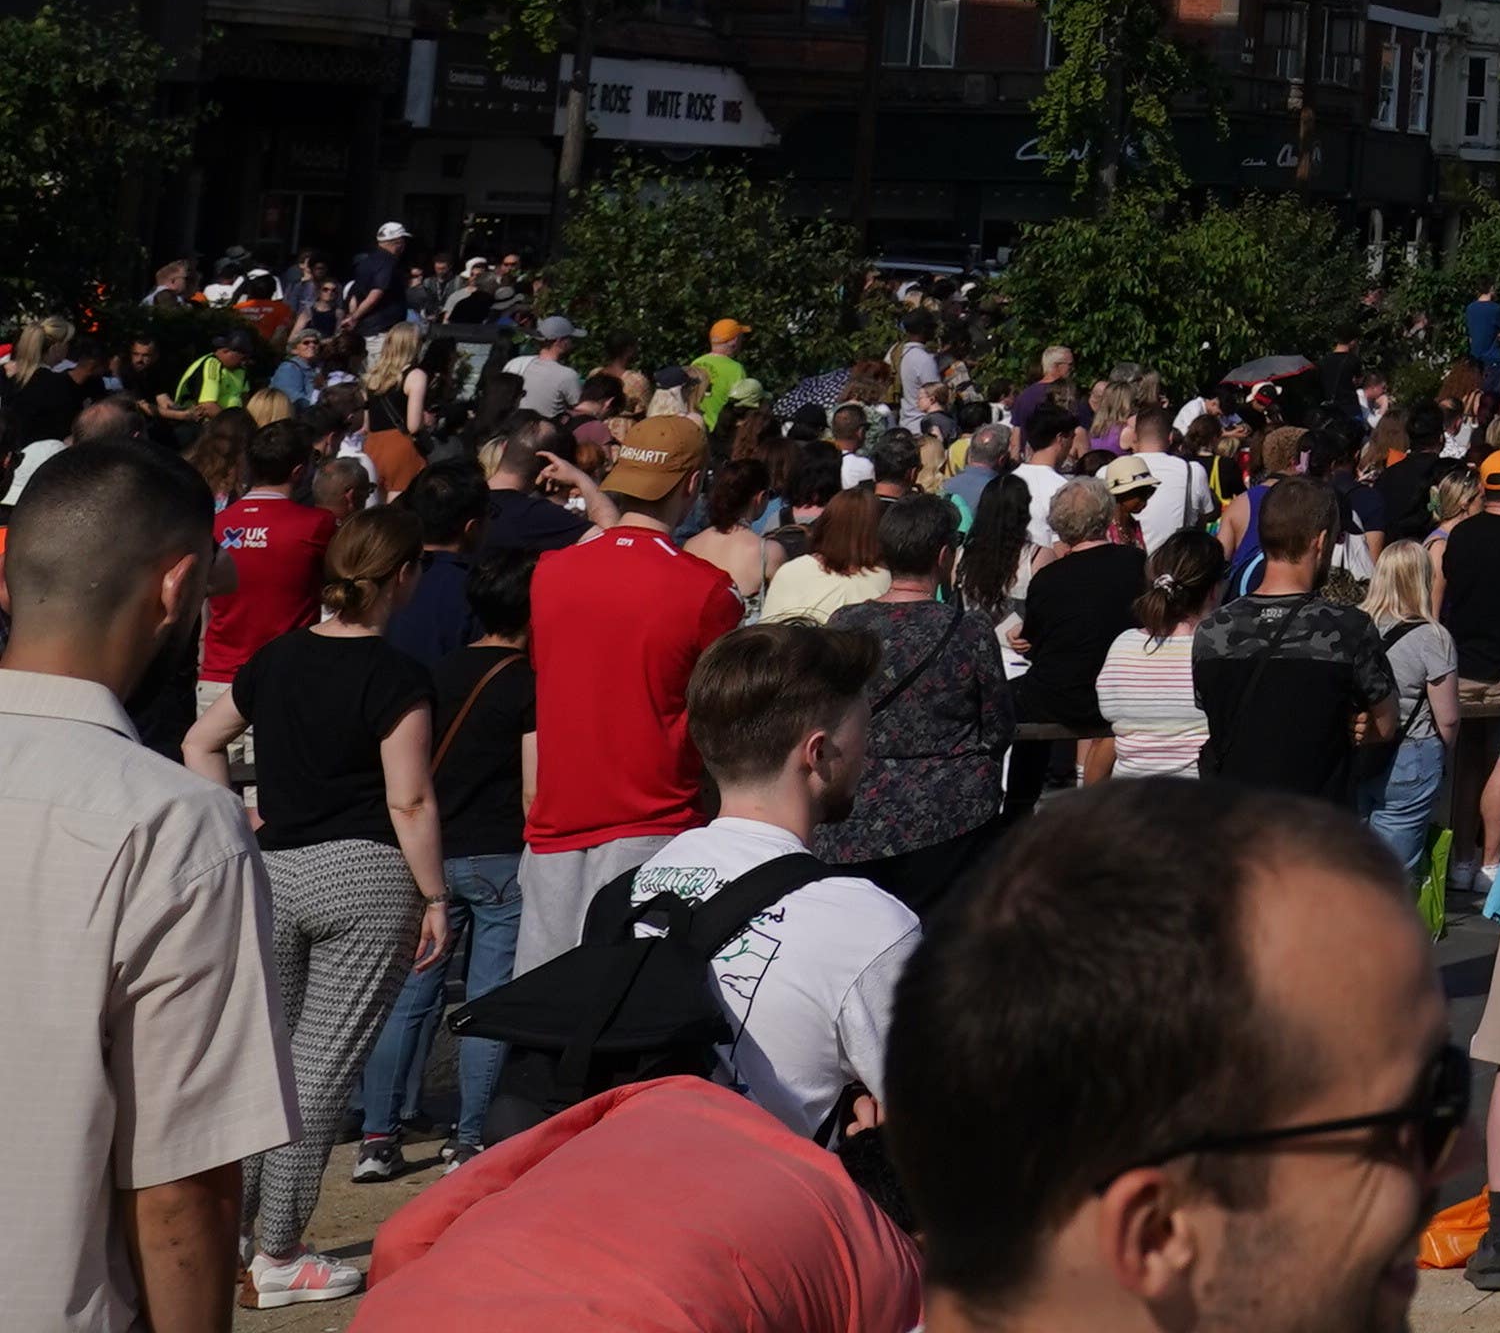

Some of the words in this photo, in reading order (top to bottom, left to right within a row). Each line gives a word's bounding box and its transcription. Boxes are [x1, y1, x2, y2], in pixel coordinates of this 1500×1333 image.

[601, 84, 633, 114] ROSE
[647, 90, 682, 120] WHITE
[686, 94, 717, 121] ROSE
[244, 539, 268, 548] Meds
[245, 527, 269, 540] UK
